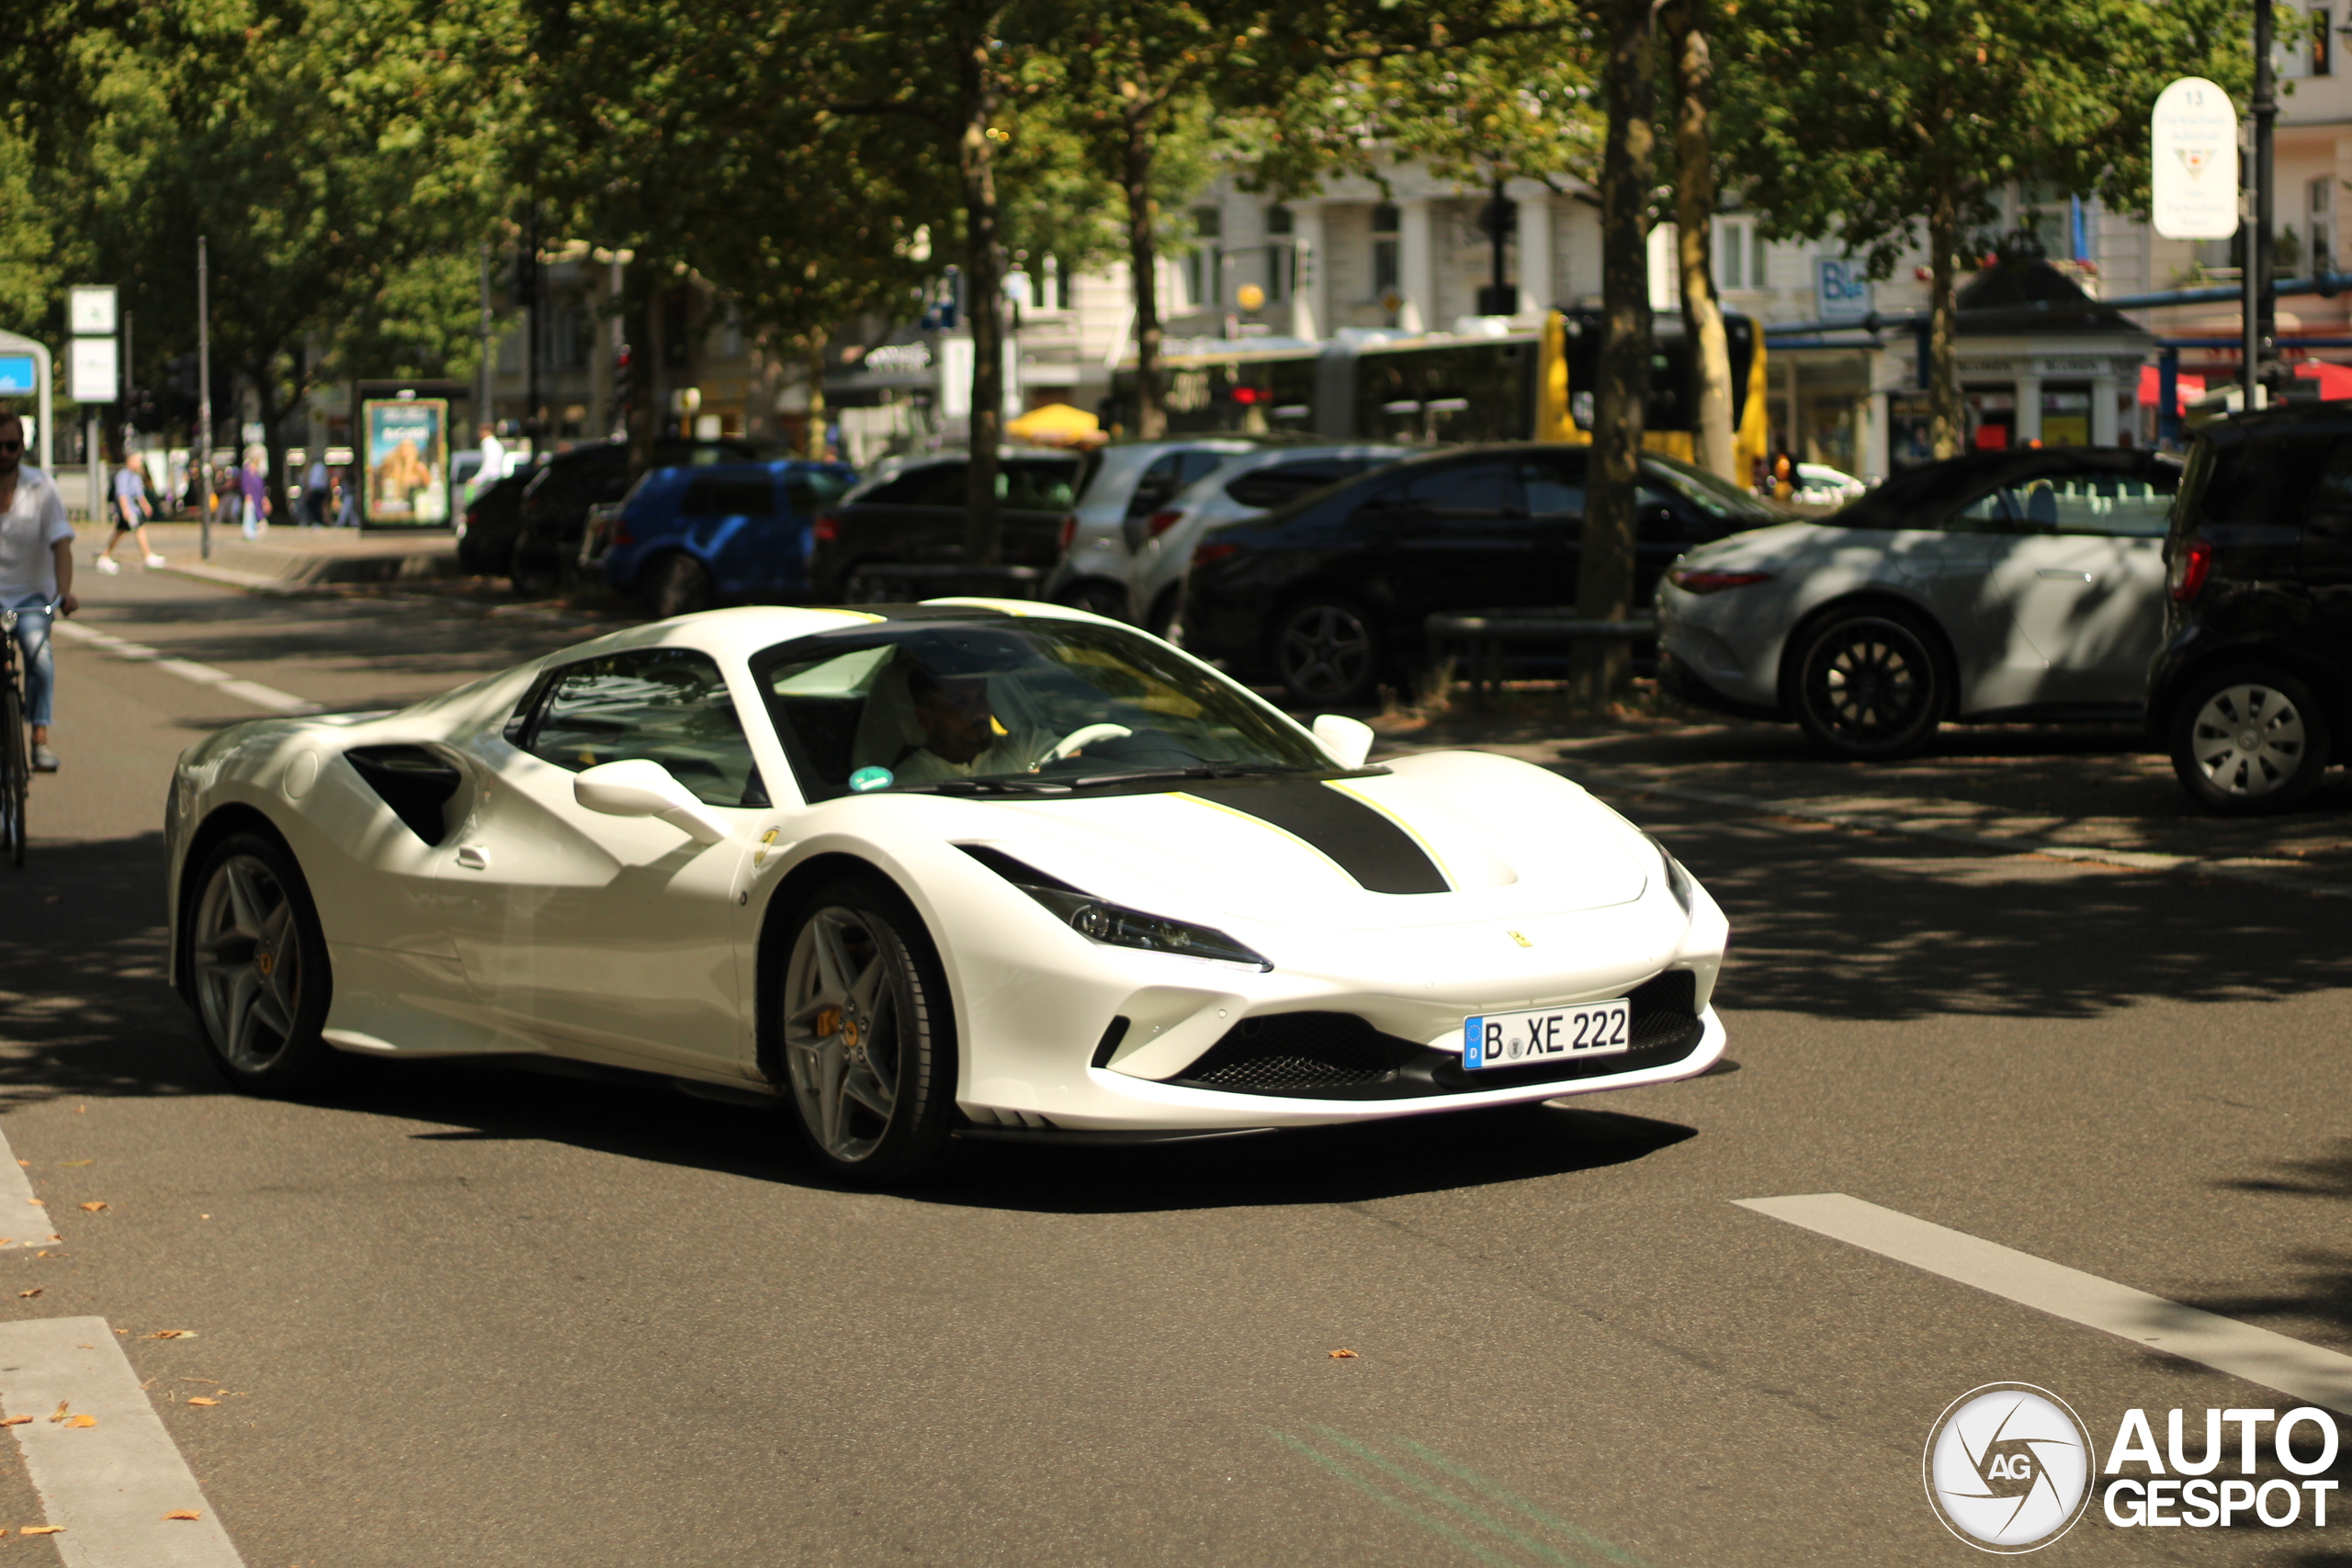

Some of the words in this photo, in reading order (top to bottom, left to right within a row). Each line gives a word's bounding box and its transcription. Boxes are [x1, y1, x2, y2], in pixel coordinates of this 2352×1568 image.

[2186, 90, 2204, 107] 13
[1486, 1022, 1503, 1059] B
[1527, 1015, 1564, 1055] XE
[1573, 1009, 1625, 1050] 222
[1470, 1047, 1477, 1059] D
